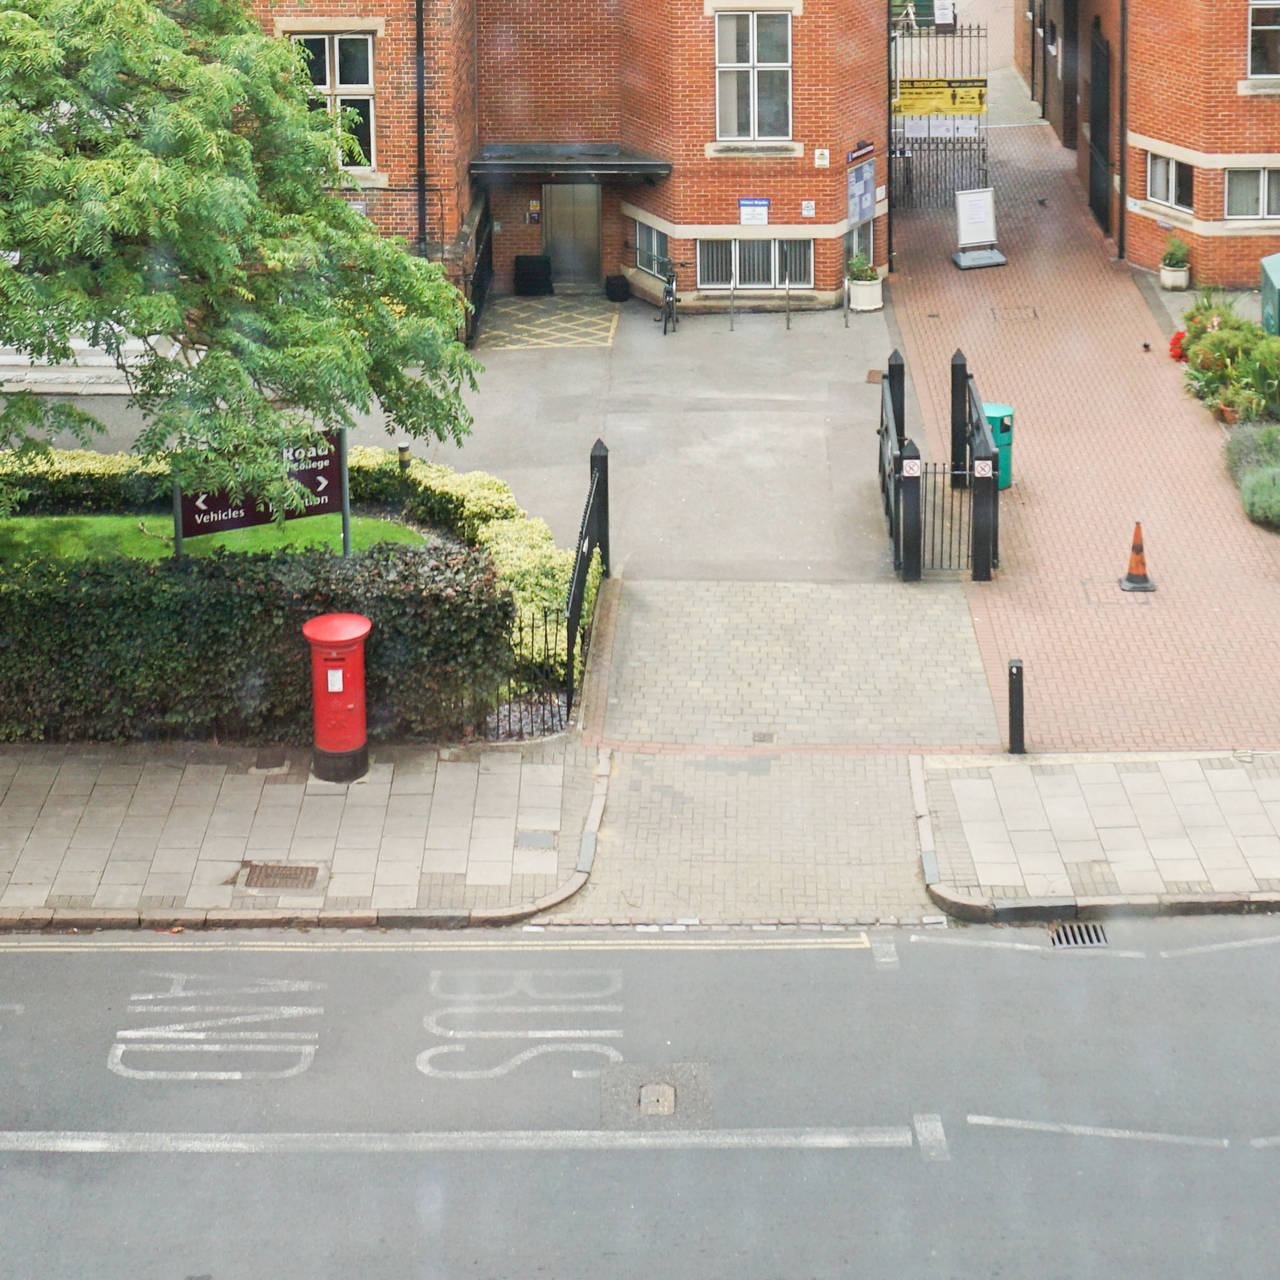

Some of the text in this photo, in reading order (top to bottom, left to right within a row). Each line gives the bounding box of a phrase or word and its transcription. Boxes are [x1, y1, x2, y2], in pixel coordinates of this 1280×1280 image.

[194, 507, 245, 524] Vehicles
[107, 969, 327, 1080] AND
[416, 969, 623, 1079] BUS
